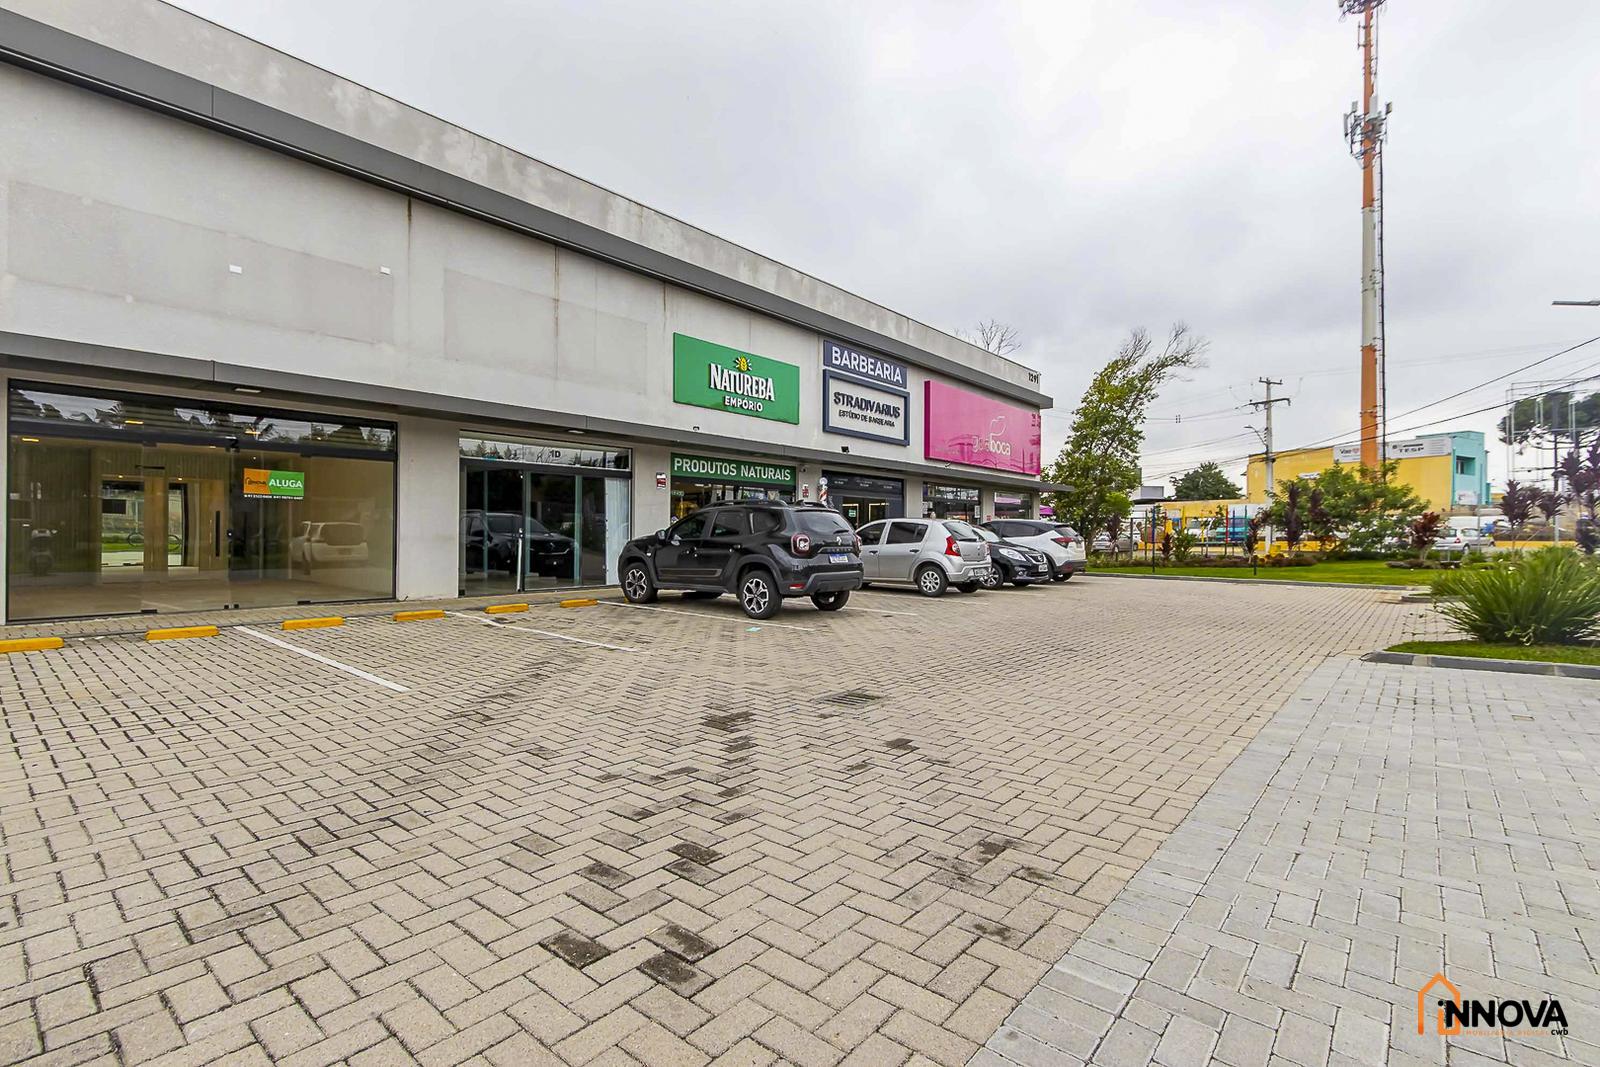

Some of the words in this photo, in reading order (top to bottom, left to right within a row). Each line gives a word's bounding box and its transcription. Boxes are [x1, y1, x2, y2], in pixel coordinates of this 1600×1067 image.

[832, 346, 902, 383] BARBEARIA
[709, 363, 775, 401] NATUREBA
[725, 396, 763, 411] EMPÓRIO
[833, 391, 900, 418] STRADIVARIUS
[861, 414, 868, 422] DE
[674, 458, 737, 476] PRODUTOS
[740, 465, 791, 480] NATURAIS
[269, 479, 302, 488] ALUGA
